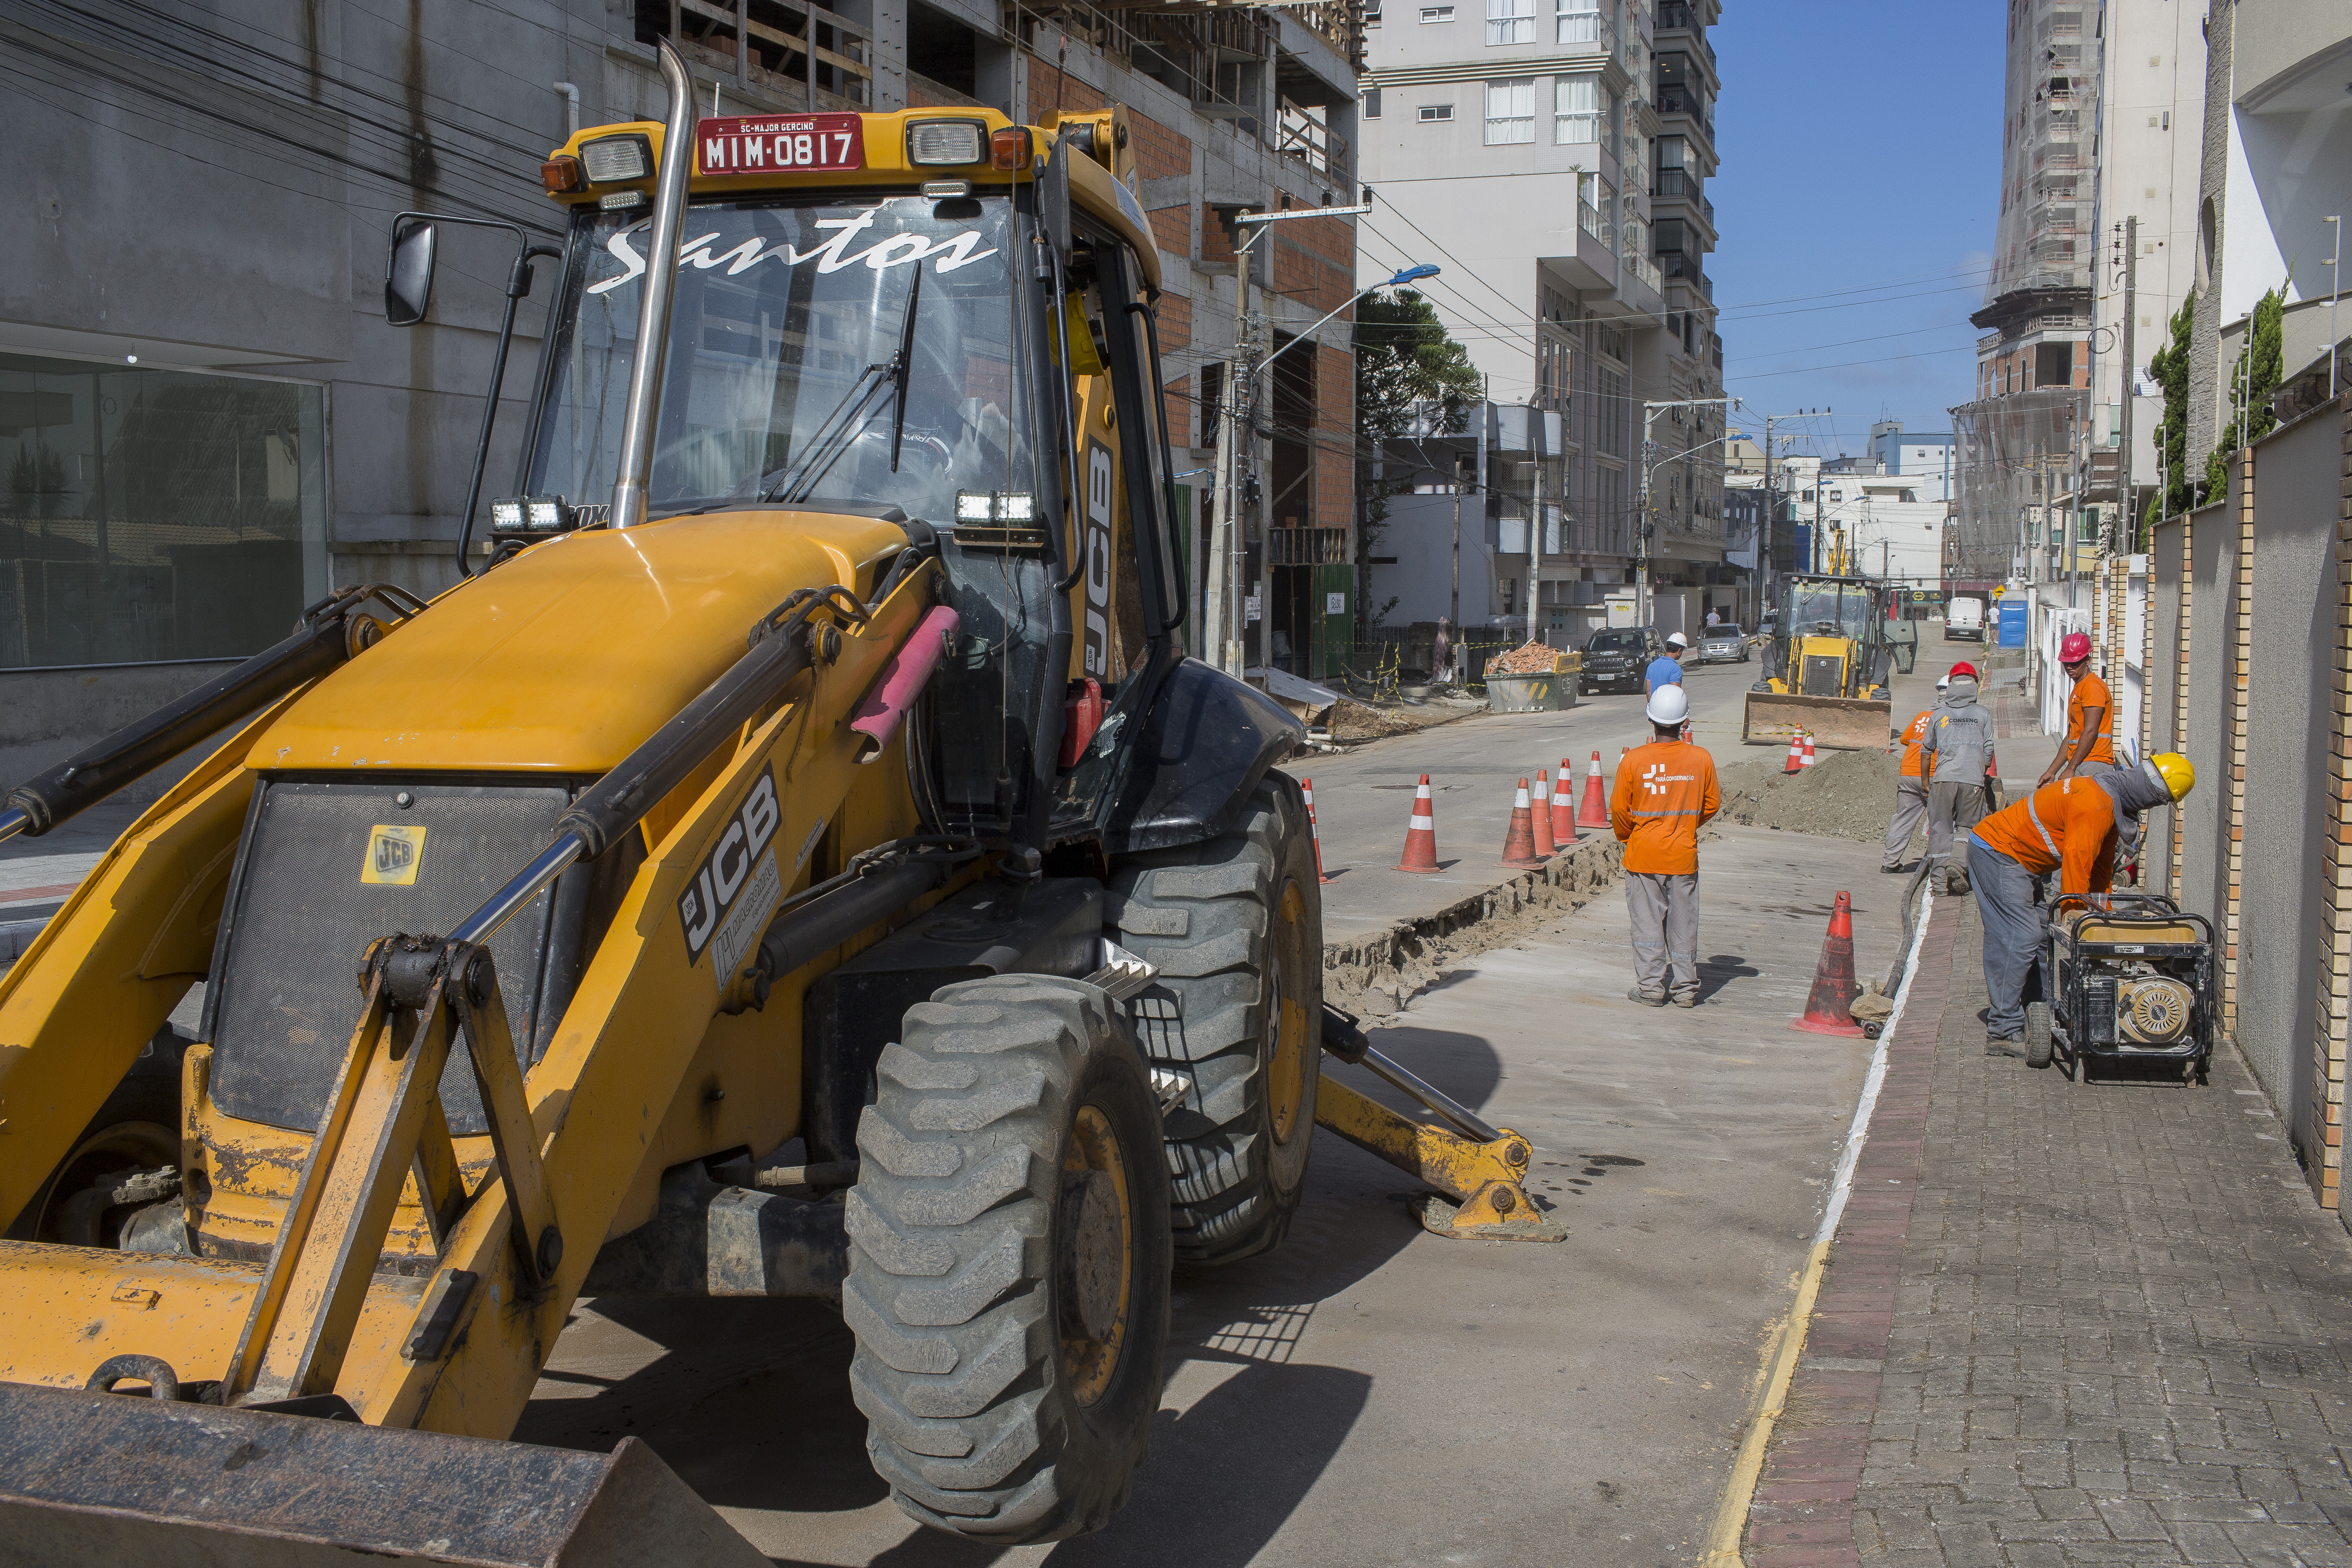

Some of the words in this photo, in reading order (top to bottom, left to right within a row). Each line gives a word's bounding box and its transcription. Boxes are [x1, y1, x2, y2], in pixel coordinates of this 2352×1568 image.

[740, 123, 779, 133] SC-MAJOR
[781, 122, 814, 131] GERCINO
[587, 209, 999, 294] Santos
[1087, 447, 1110, 675] JCB
[379, 839, 411, 869] JCB
[688, 775, 777, 951] JCB
[733, 858, 775, 938] MACROMAQ
[752, 875, 778, 919] Equipamentos
[2152, 1005, 2165, 1020] BUFFALO
